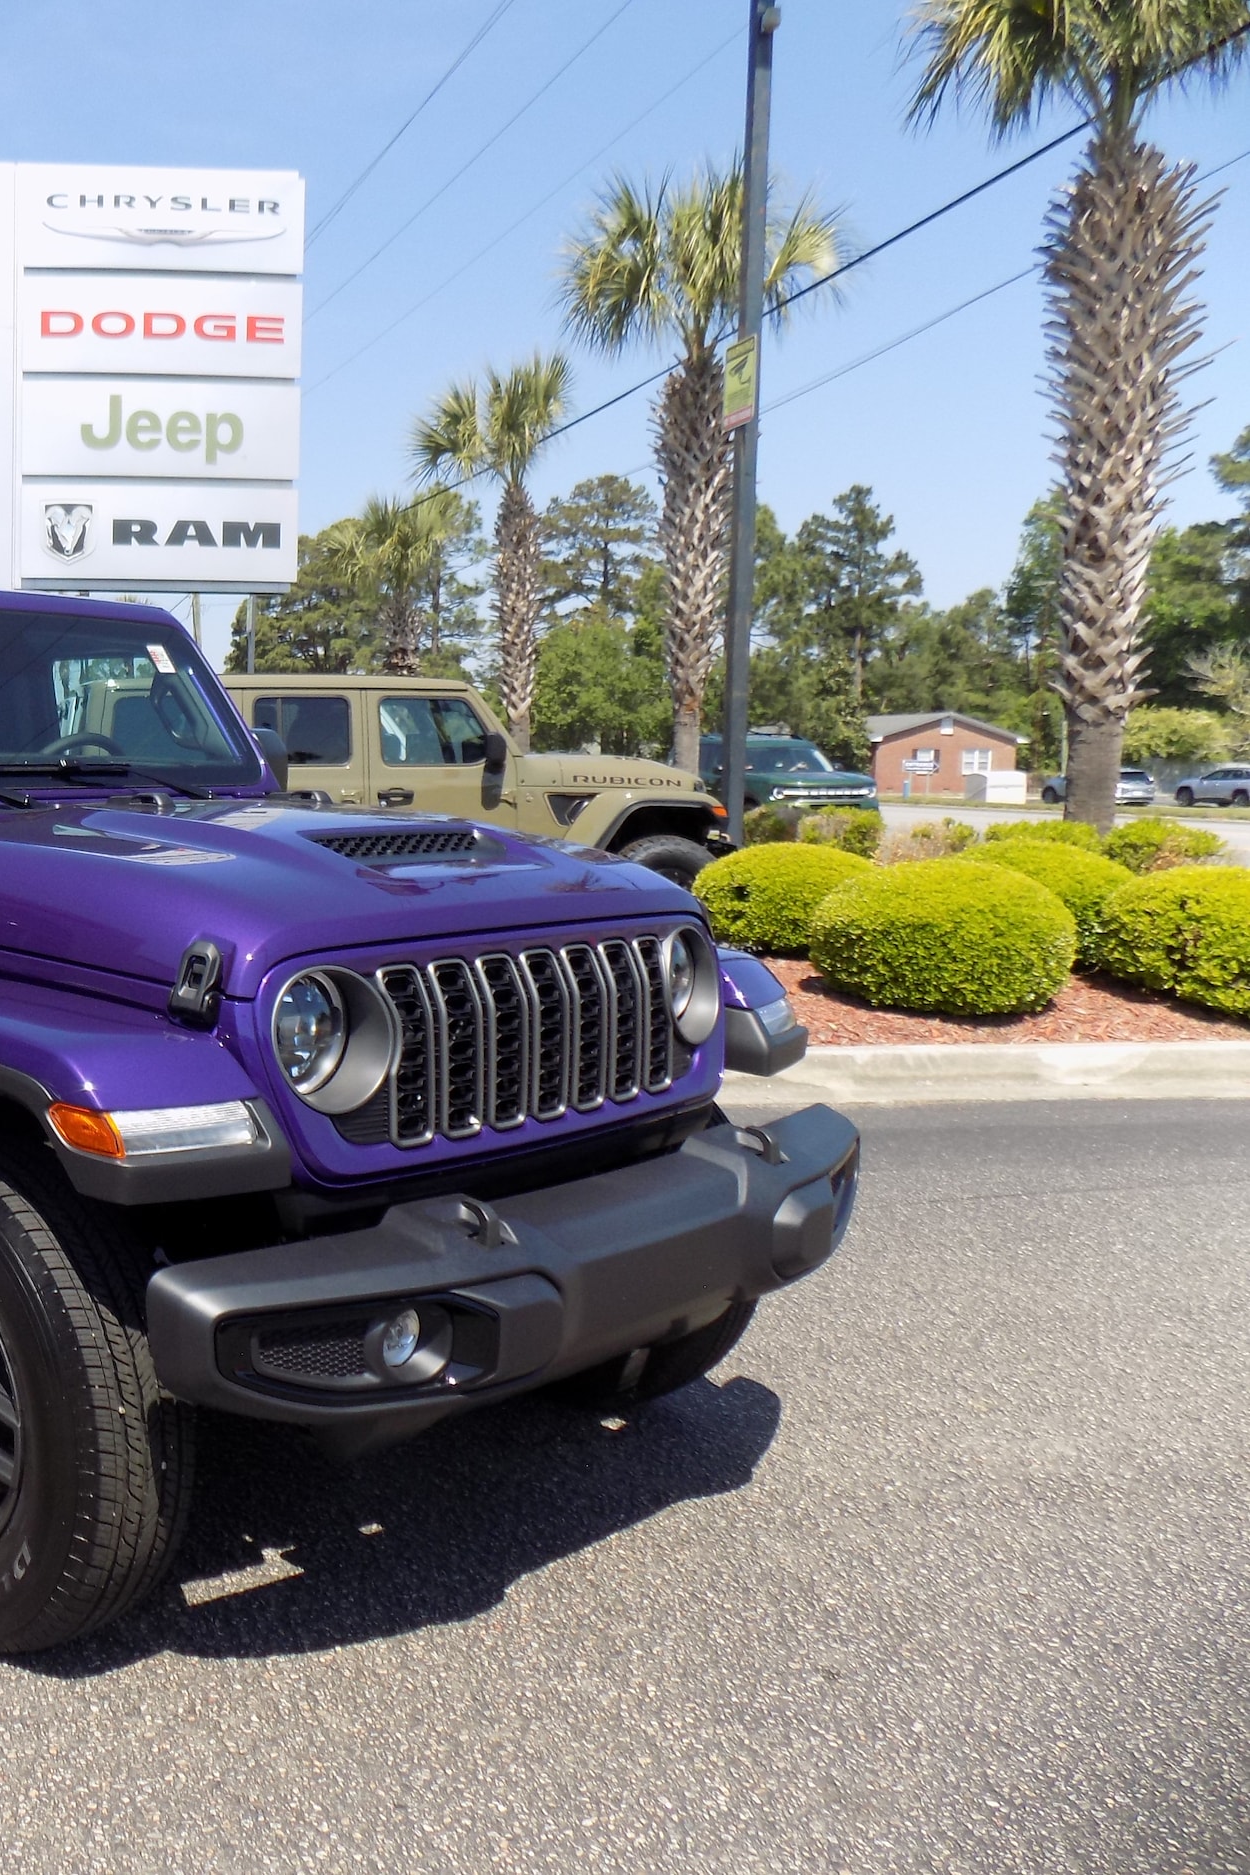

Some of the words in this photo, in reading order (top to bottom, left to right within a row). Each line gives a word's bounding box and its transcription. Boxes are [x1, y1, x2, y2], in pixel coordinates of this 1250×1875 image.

[46, 193, 280, 215] CHRYSLER
[40, 311, 285, 344] DODGE
[80, 394, 244, 465] Jeep
[112, 519, 281, 549] RAM
[573, 775, 682, 788] RUBICON
